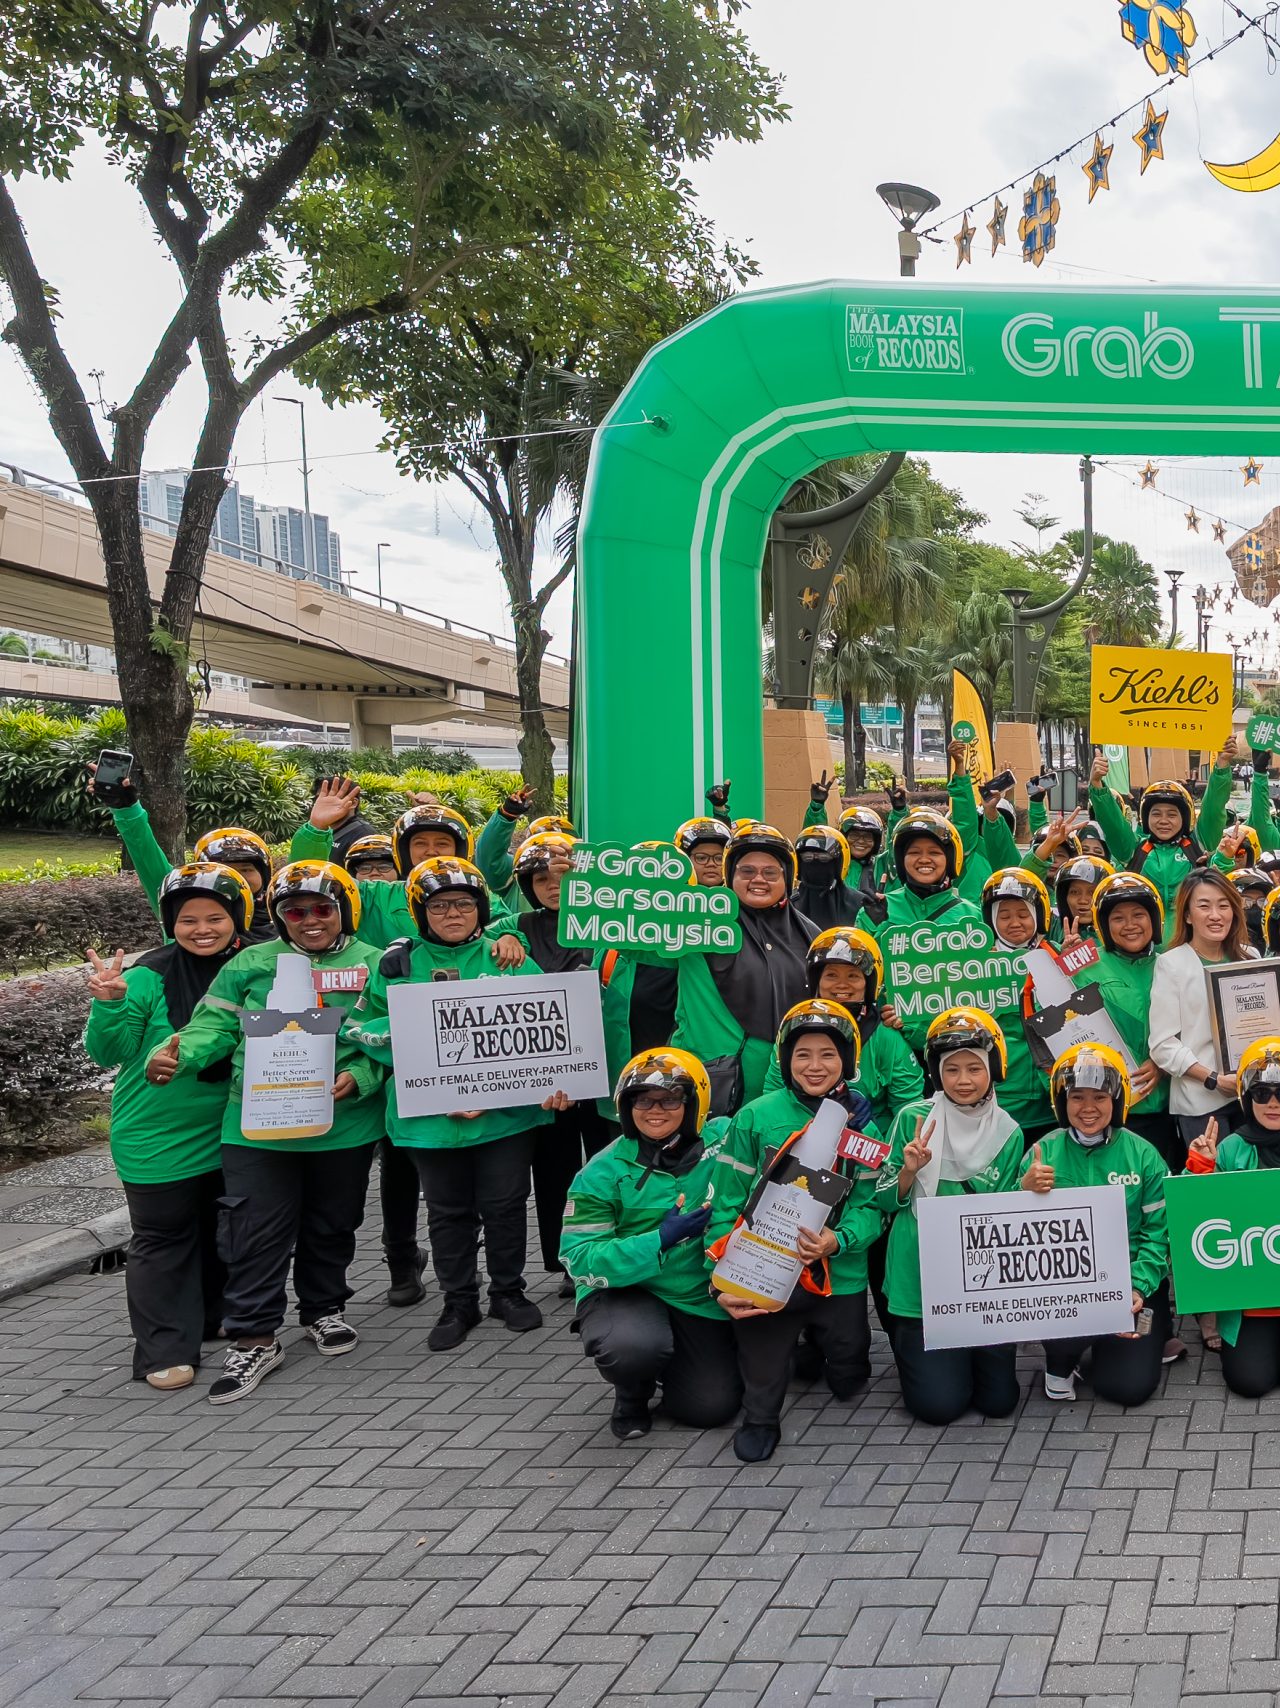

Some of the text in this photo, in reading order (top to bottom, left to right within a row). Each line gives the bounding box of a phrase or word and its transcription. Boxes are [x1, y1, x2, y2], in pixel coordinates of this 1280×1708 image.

[850, 314, 958, 336] MALAYSIA
[850, 334, 874, 348] BOOK
[1002, 311, 1194, 380] Grab
[855, 338, 961, 369] of RECORDS
[1099, 667, 1219, 705] Kiehl's
[957, 728, 970, 738] 28
[1128, 720, 1203, 731] SINCE 1851
[570, 849, 685, 880] #Grab
[568, 880, 731, 914] Bersama
[566, 914, 735, 951] Malaysia
[889, 923, 988, 955] #Grab
[1062, 945, 1095, 972] NEW!
[321, 970, 358, 989] NEW!
[436, 1000, 467, 1008] THE
[893, 981, 1020, 1017] Malaysi
[1236, 995, 1264, 1004] MALAYSIA
[1244, 1001, 1265, 1010] RECORDS
[438, 1000, 564, 1030] MALAYSIA
[440, 1029, 469, 1044] BOOK
[447, 1024, 567, 1063] of RECORDS
[405, 1061, 598, 1088] MOST FEMALE DELIVERY-PARTNERS
[457, 1077, 554, 1095] IN A CONVOY 2026
[843, 1134, 881, 1163] NEW!
[1107, 1171, 1140, 1185] Grab
[772, 1203, 802, 1219] KIEHL'S
[964, 1216, 993, 1226] THE
[755, 1220, 798, 1241] Better Screen
[756, 1228, 791, 1247] UV Serum
[965, 1218, 1089, 1250] MALAYSIA
[966, 1250, 995, 1265] BOOK
[972, 1246, 1092, 1288] of RECORDS
[931, 1290, 1123, 1316] MOST FEMALE DELIVERY-PARTNERS
[982, 1307, 1078, 1324] IN A CONVOY 2026
